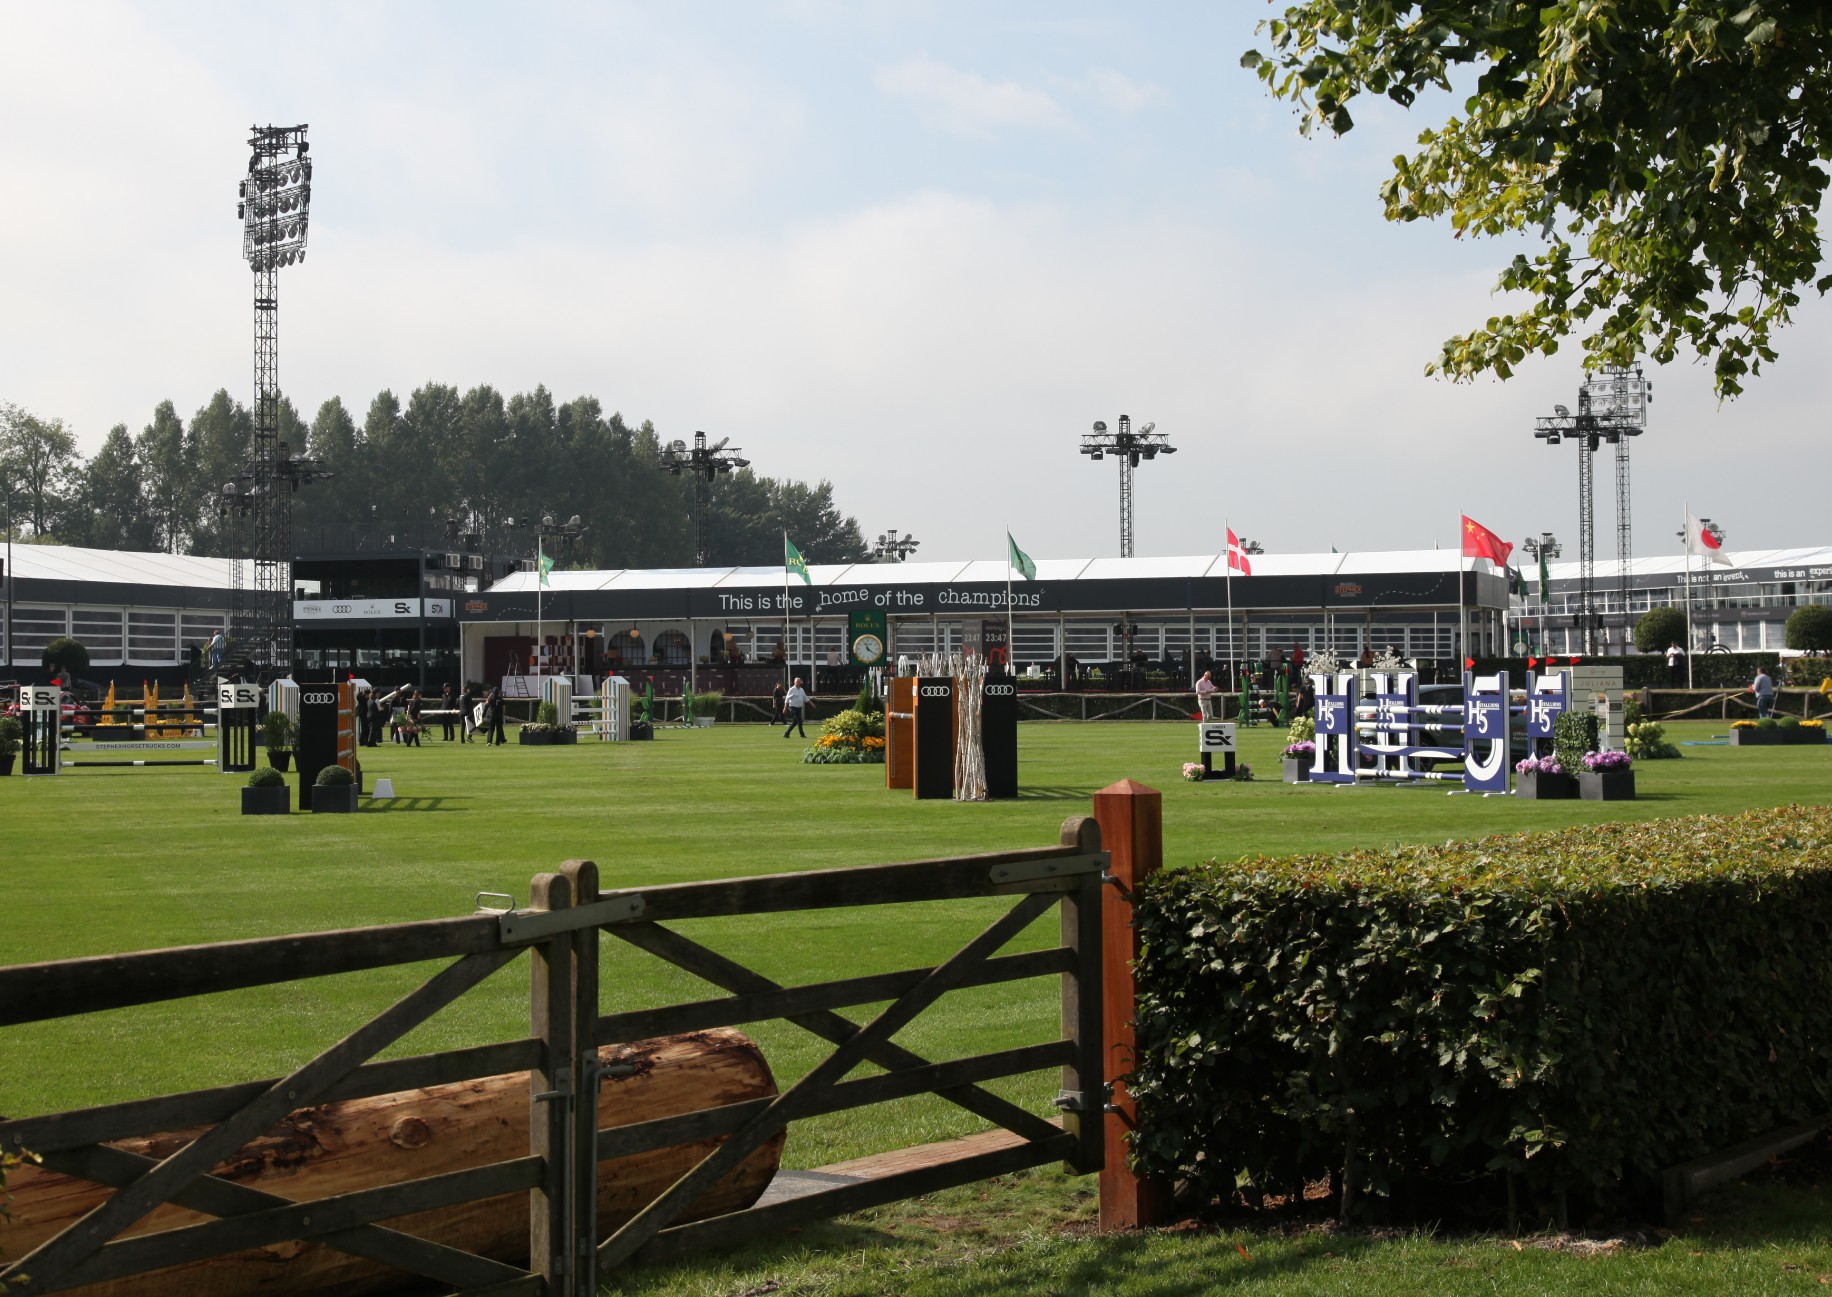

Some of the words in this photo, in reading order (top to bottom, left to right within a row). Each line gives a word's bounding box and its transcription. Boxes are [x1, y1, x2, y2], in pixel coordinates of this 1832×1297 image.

[1691, 574, 1697, 582] is
[1774, 570, 1787, 578] this
[719, 594, 753, 610] This
[758, 593, 771, 609] is
[776, 593, 803, 609] the
[819, 588, 869, 606] home
[874, 590, 892, 606] of
[896, 590, 924, 606] the
[938, 588, 1040, 609] champions
[964, 633, 980, 642] 23:47
[985, 633, 1007, 642] 23:47
